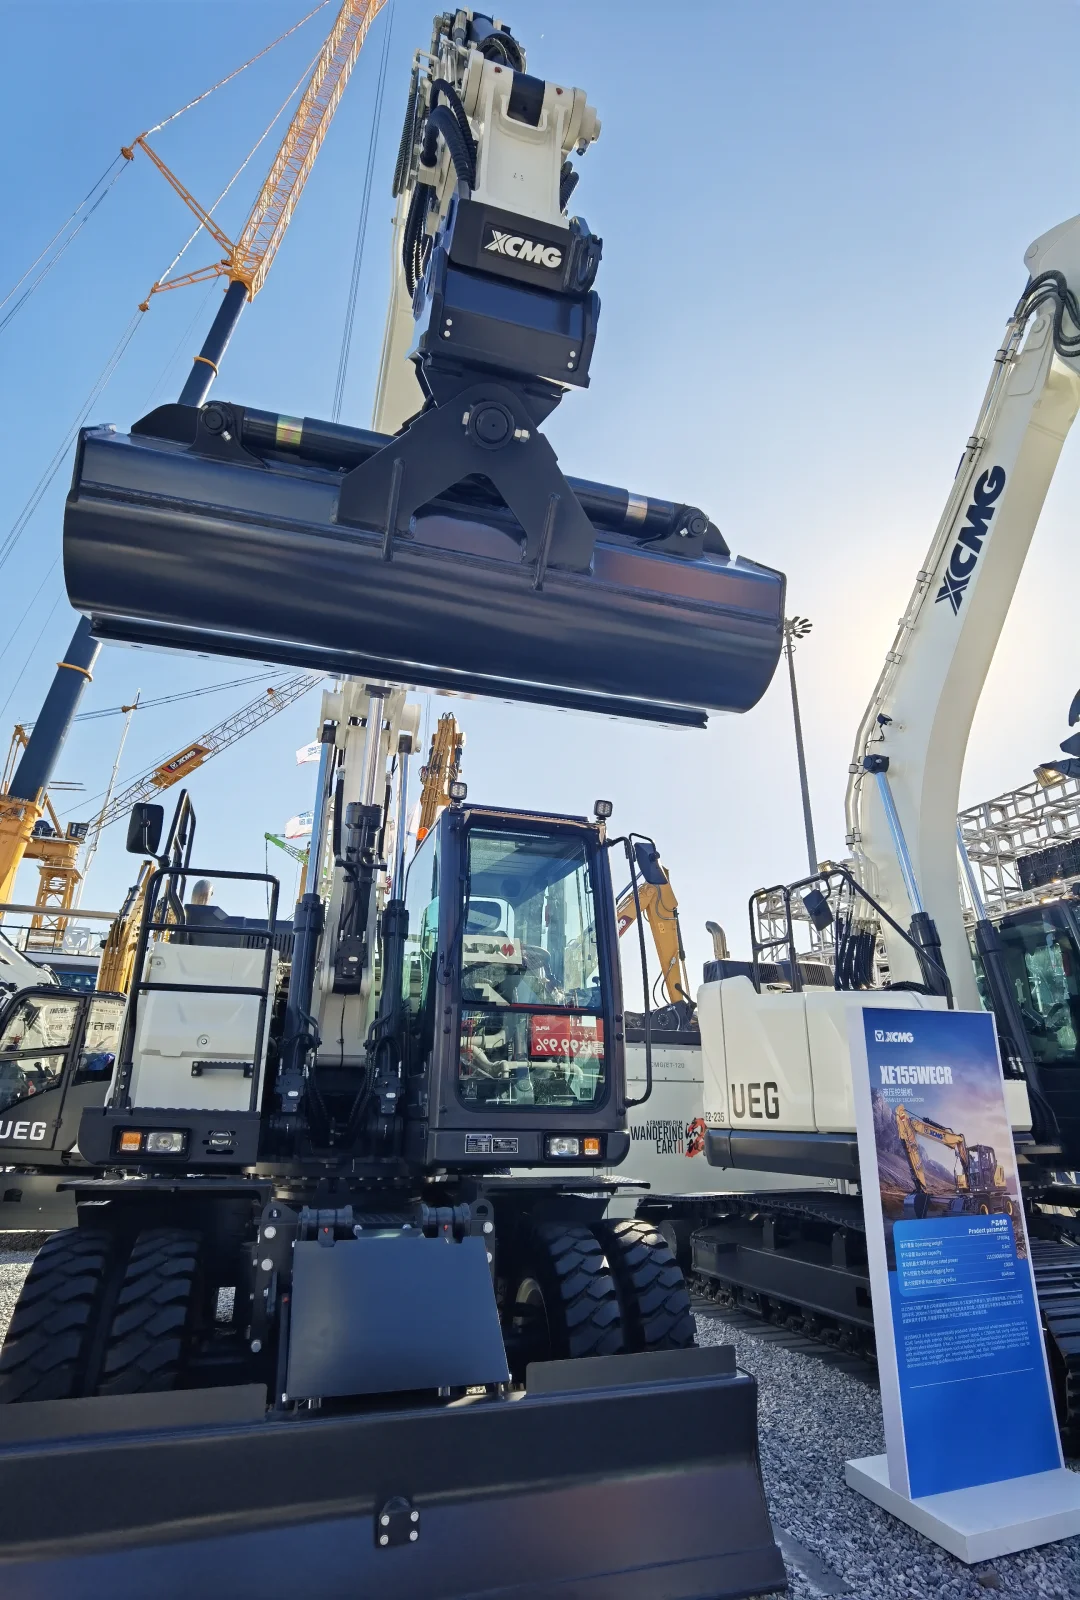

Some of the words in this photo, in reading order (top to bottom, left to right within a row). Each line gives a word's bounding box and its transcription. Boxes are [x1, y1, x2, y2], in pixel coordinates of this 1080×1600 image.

[484, 230, 562, 268] XCMG
[935, 466, 1006, 616] XCMG
[176, 750, 196, 765] XCMG
[885, 1031, 914, 1043] XCMG
[880, 1065, 952, 1085] XE155WECR
[731, 1082, 779, 1119] UEG
[0, 1121, 47, 1140] UEG
[630, 1126, 683, 1140] WANDERING
